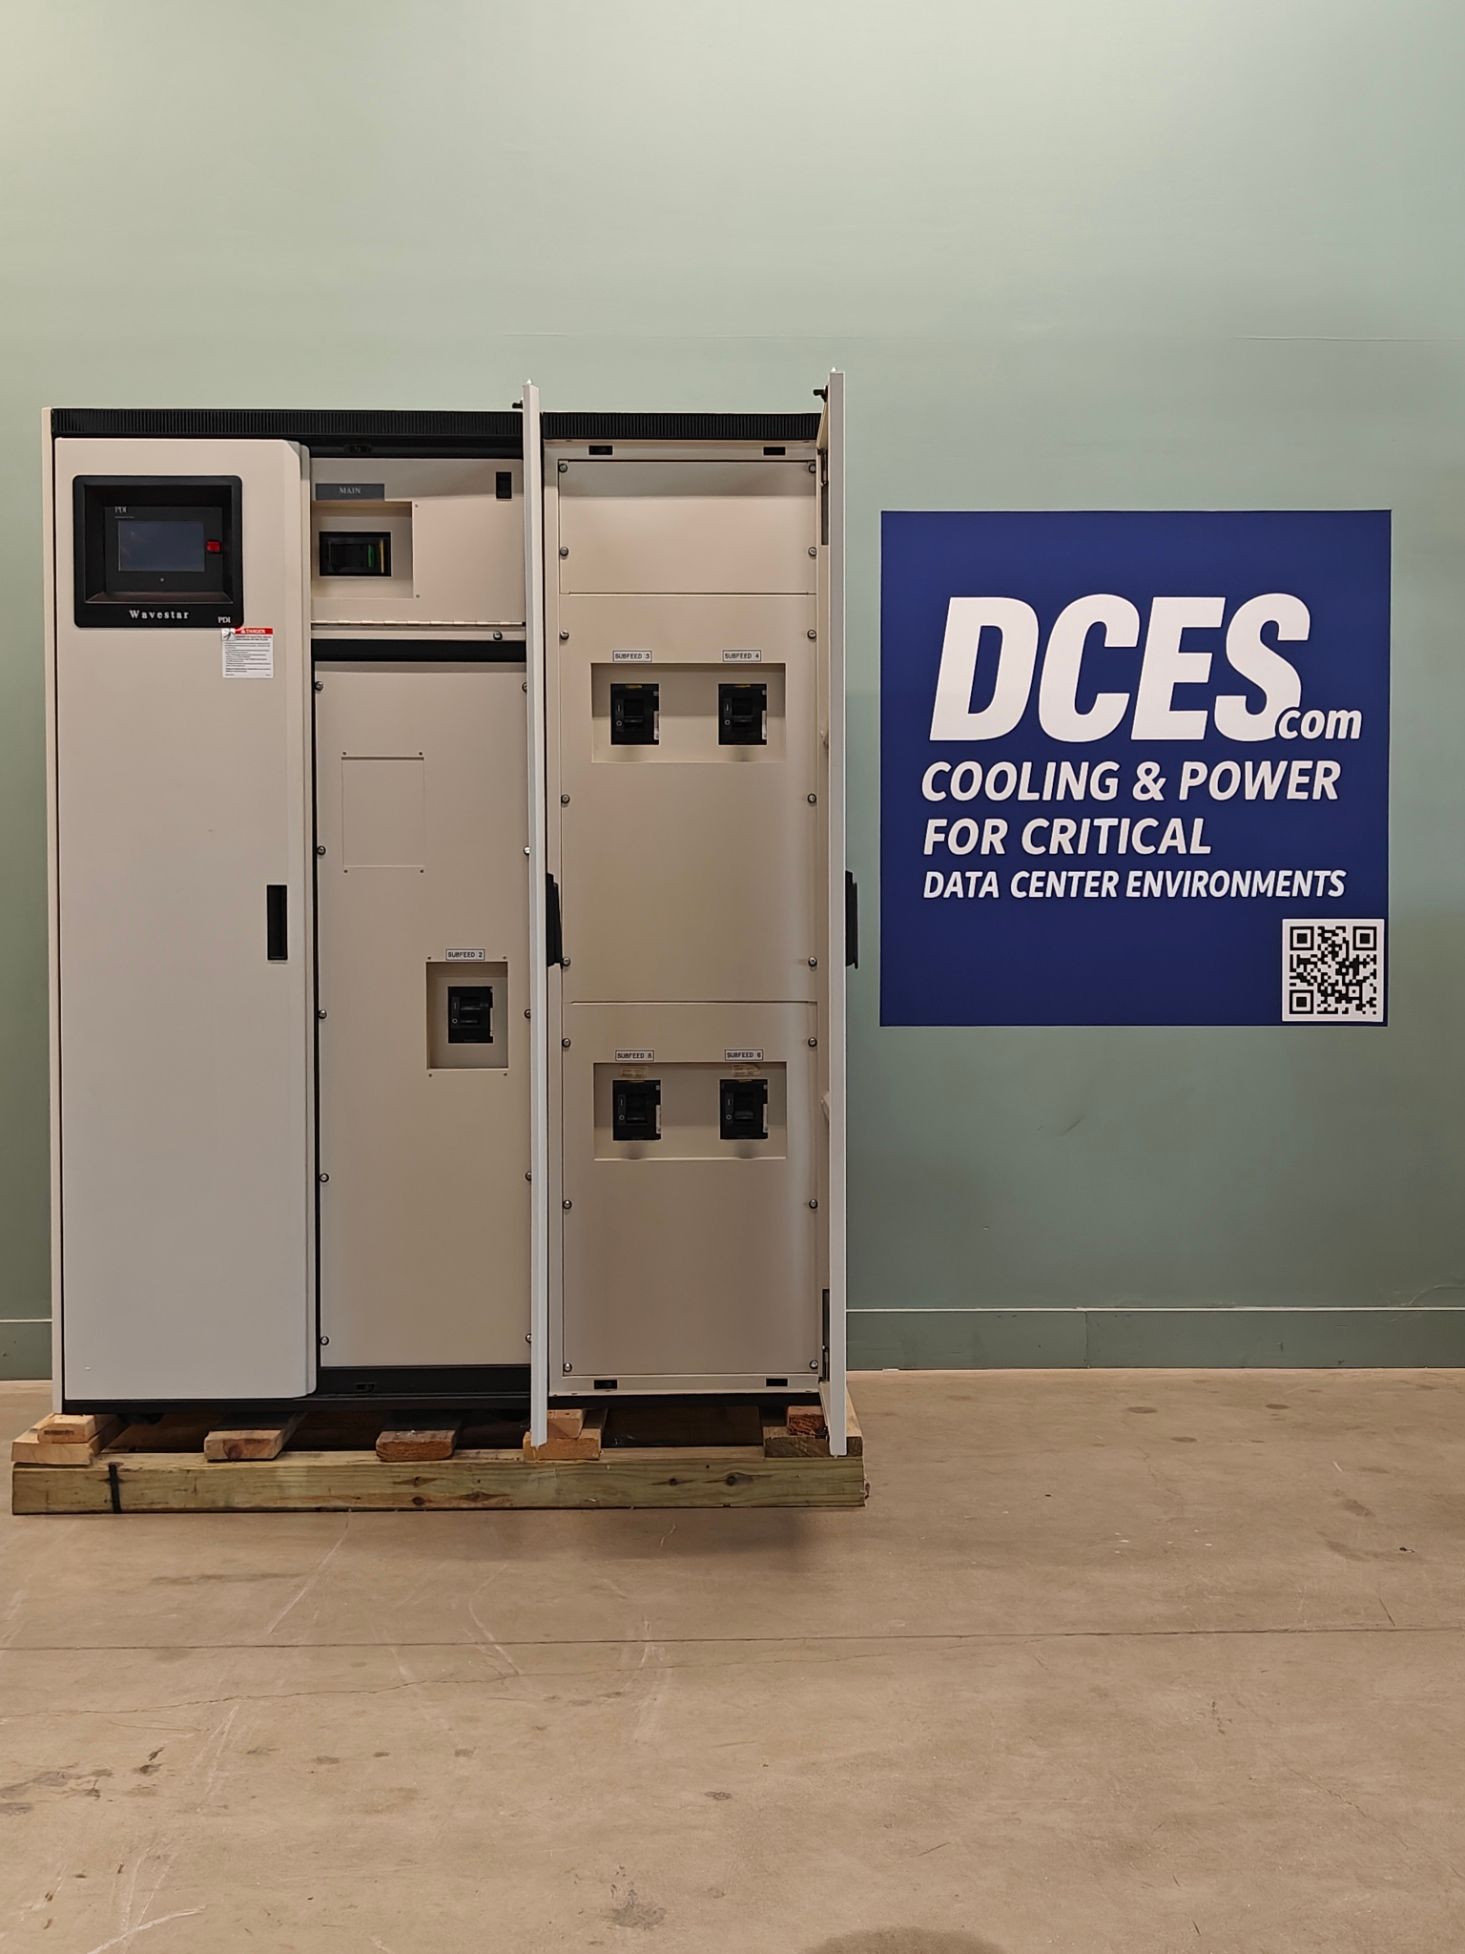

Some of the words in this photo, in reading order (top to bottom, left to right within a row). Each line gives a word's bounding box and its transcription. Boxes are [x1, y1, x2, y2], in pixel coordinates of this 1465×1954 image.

[339, 487, 362, 495] MAIN
[128, 609, 190, 620] Wavestar
[217, 616, 231, 624] PDI
[929, 593, 1311, 743] DCES
[1278, 709, 1362, 740] com
[921, 761, 1120, 802] COOLING
[1132, 761, 1167, 802] &
[1178, 760, 1341, 802] POWER
[923, 818, 1008, 855] FOR
[1021, 817, 1212, 855] CRITICAL
[923, 871, 1000, 899] DATA
[1010, 870, 1120, 899] CENTER
[1125, 869, 1347, 899] ENVIRONMENTS
[447, 951, 476, 959] SUBFEED
[726, 1051, 754, 1059] SUBFEED
